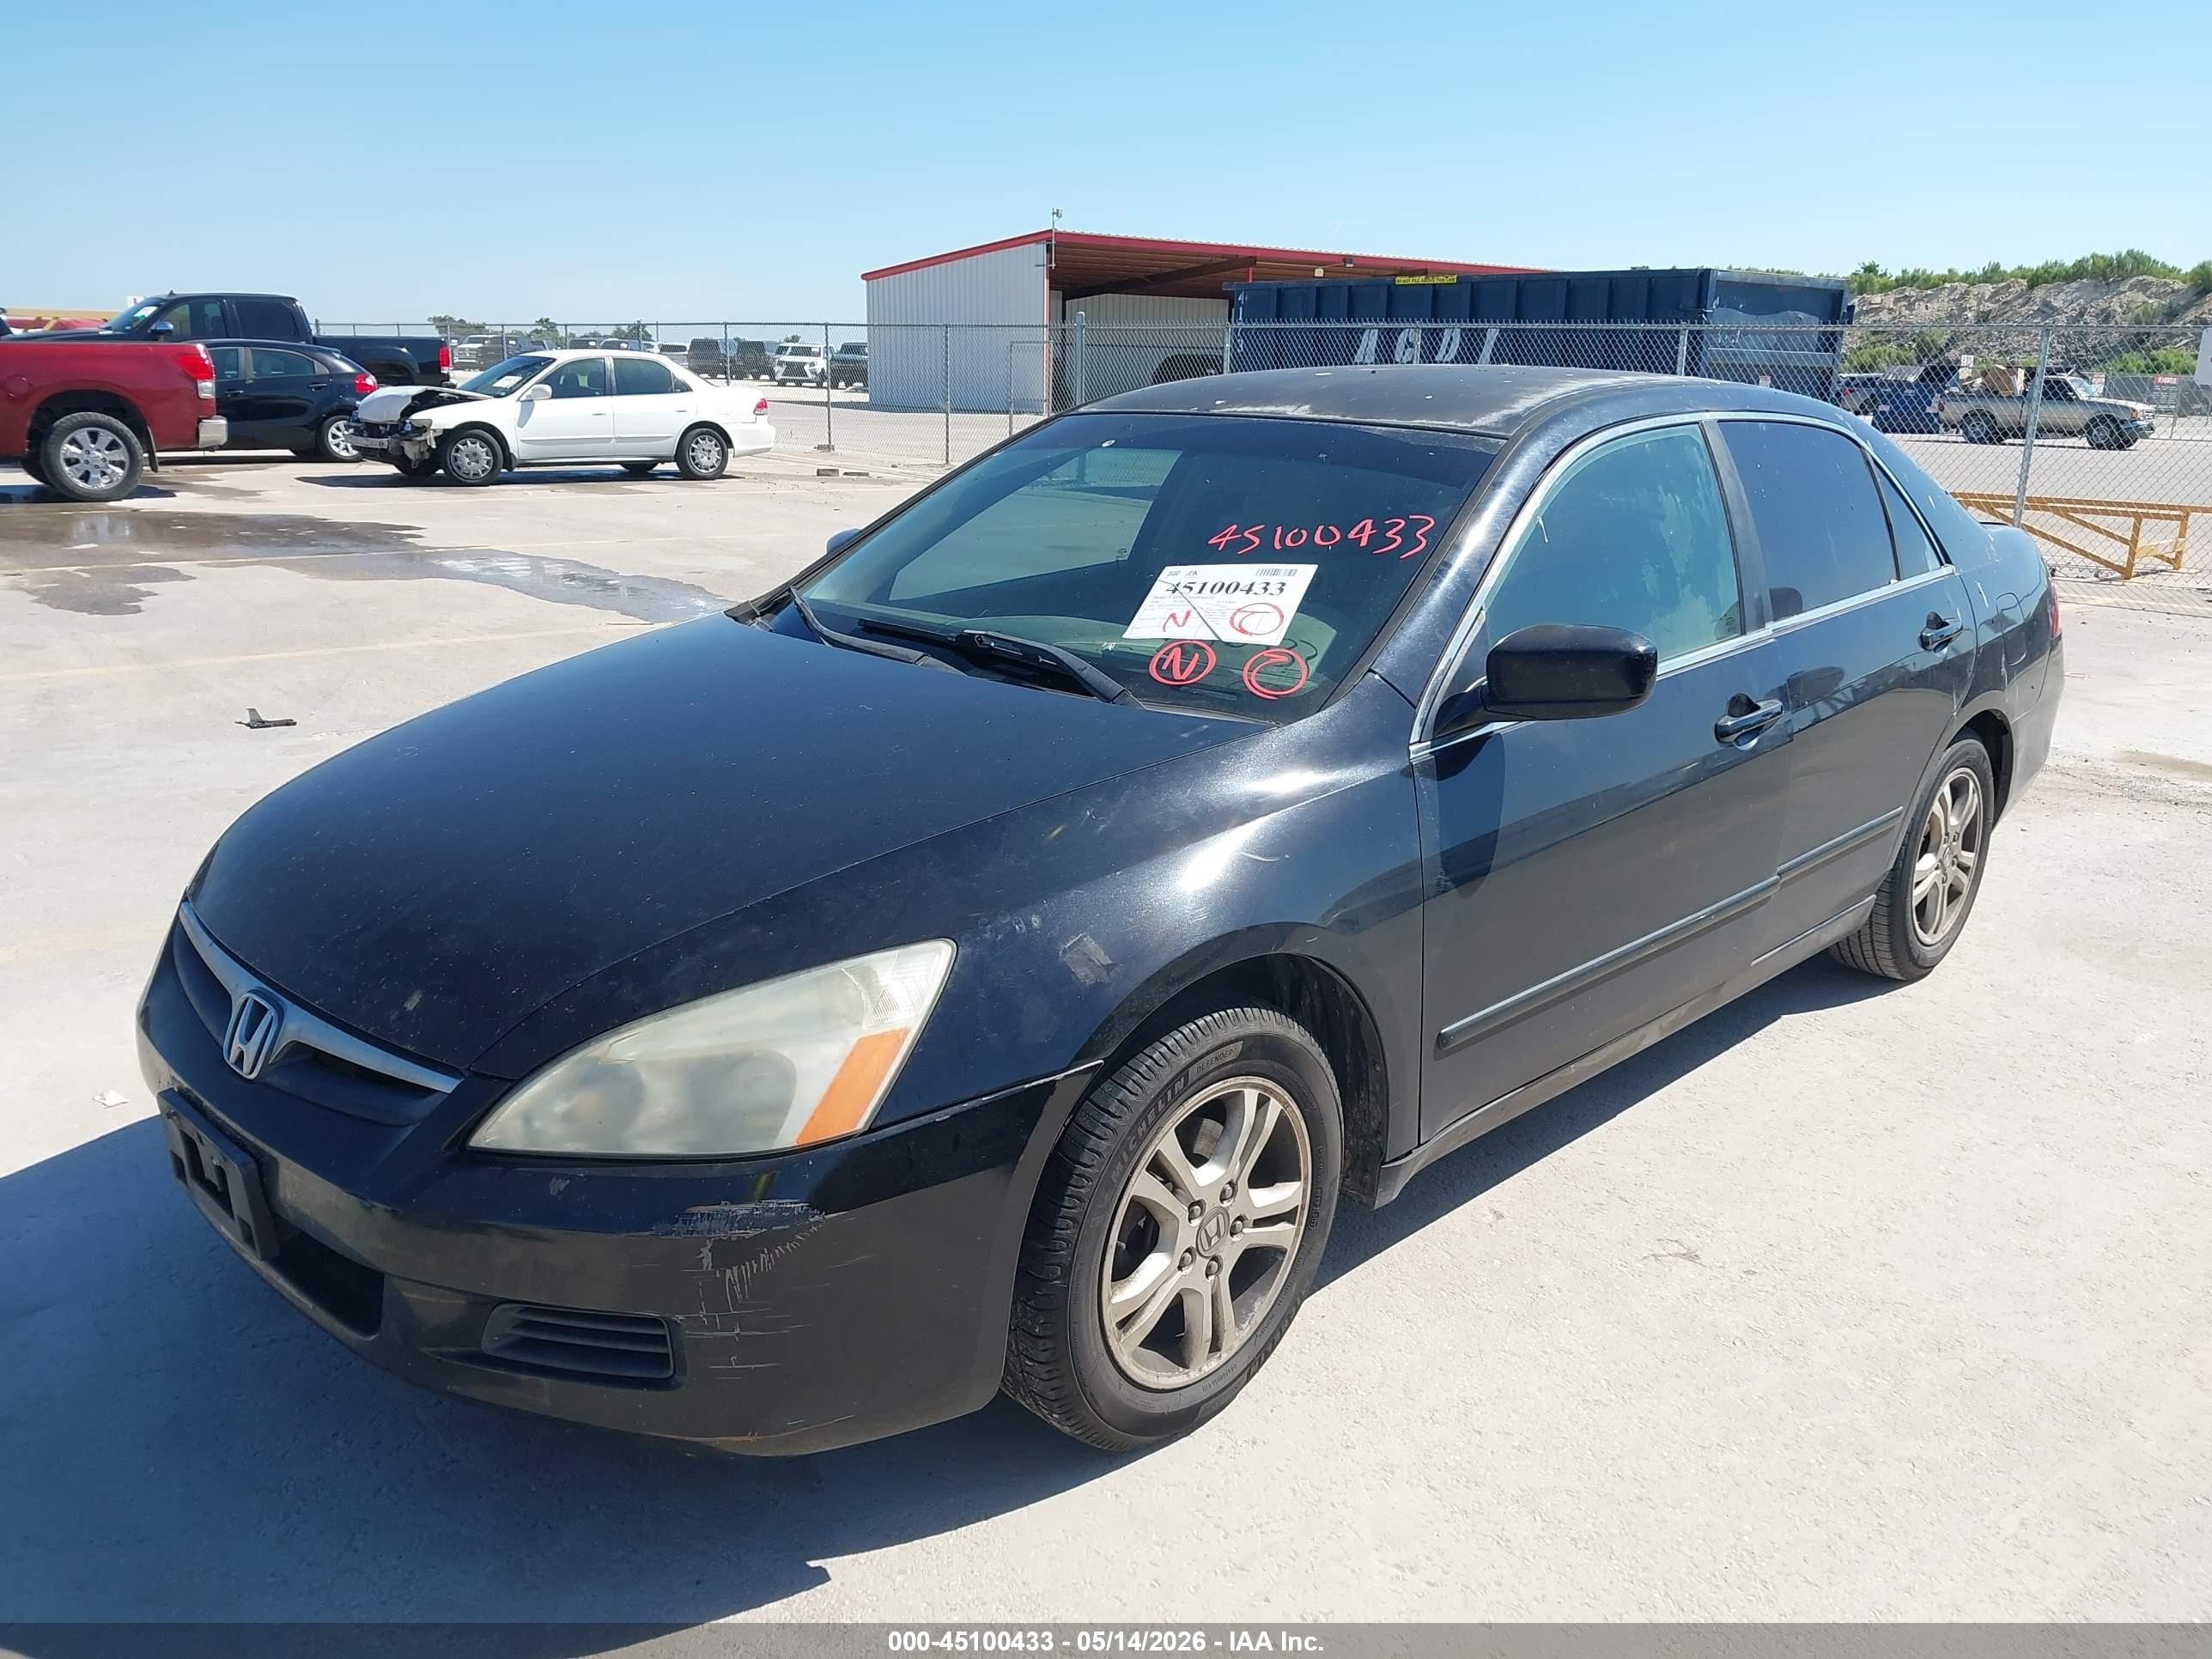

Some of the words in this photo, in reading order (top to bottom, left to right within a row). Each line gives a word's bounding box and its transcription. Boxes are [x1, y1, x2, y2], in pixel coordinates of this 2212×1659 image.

[1207, 515, 1435, 559] 45100433
[1166, 580, 1287, 596] 45100433
[1163, 609, 1192, 632] N
[1161, 647, 1200, 680] N
[1111, 1075, 1188, 1184] MICHELIN
